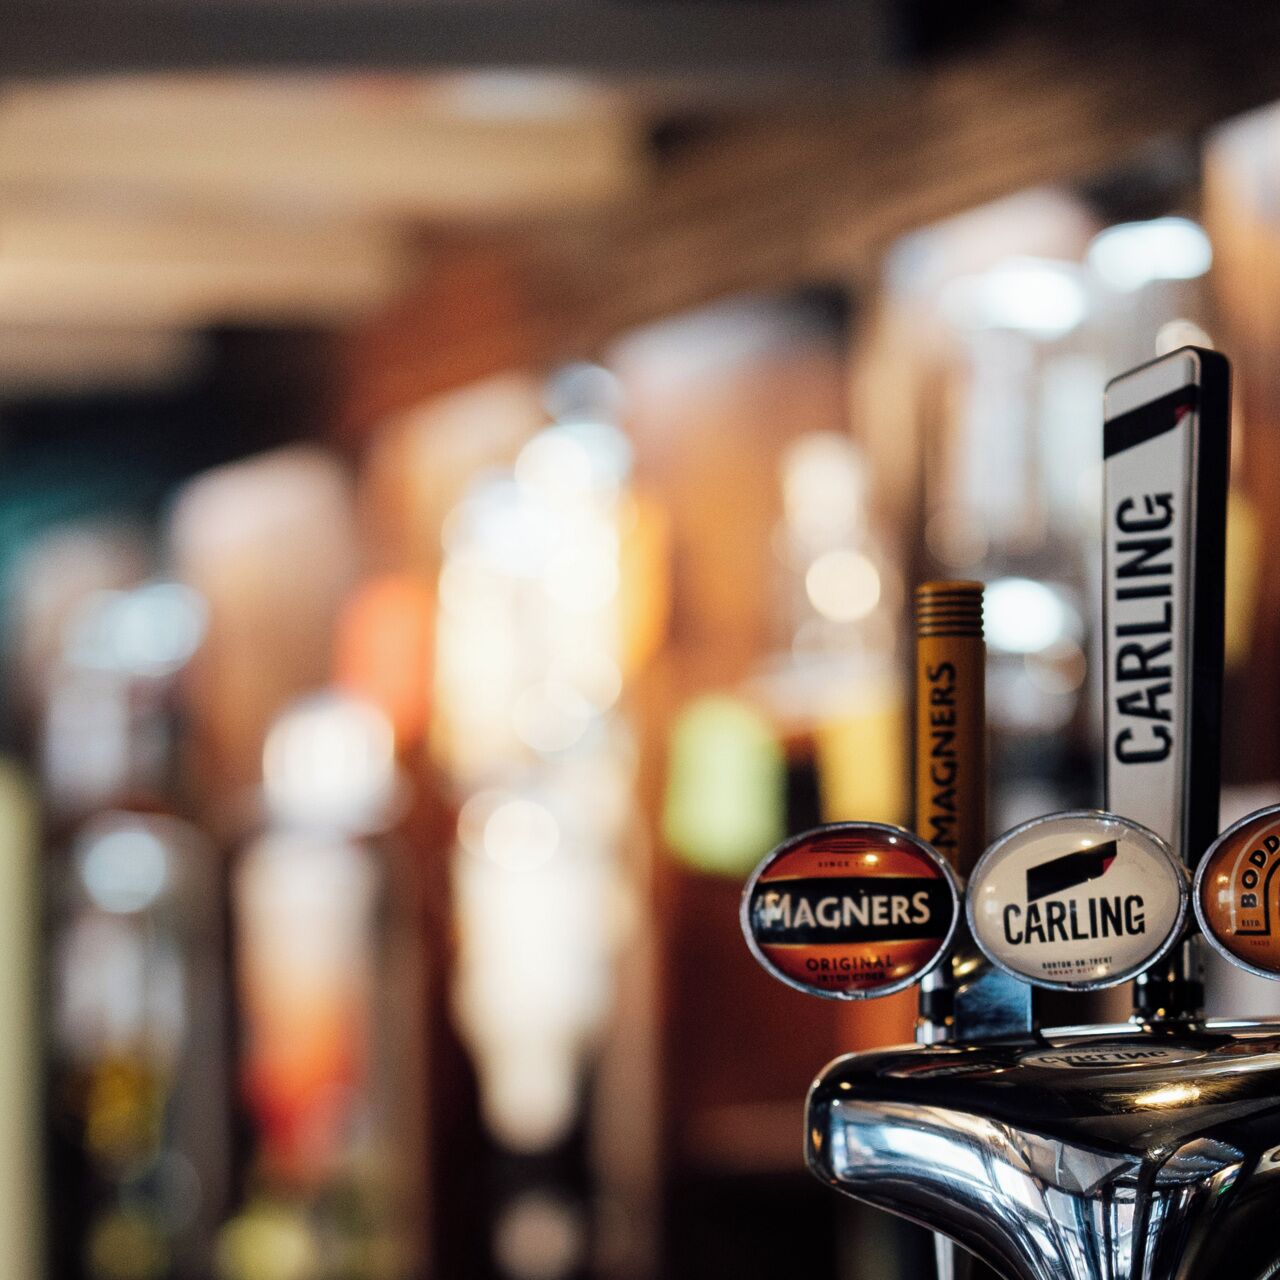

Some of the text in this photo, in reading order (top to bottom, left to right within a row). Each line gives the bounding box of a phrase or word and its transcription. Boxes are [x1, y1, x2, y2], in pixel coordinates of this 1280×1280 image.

[1114, 492, 1174, 765] CARLING
[927, 661, 958, 848] MAGNERS
[764, 890, 931, 929] MAGNERS
[1003, 894, 1146, 945] CARLING
[805, 954, 894, 972] ORIGINAL
